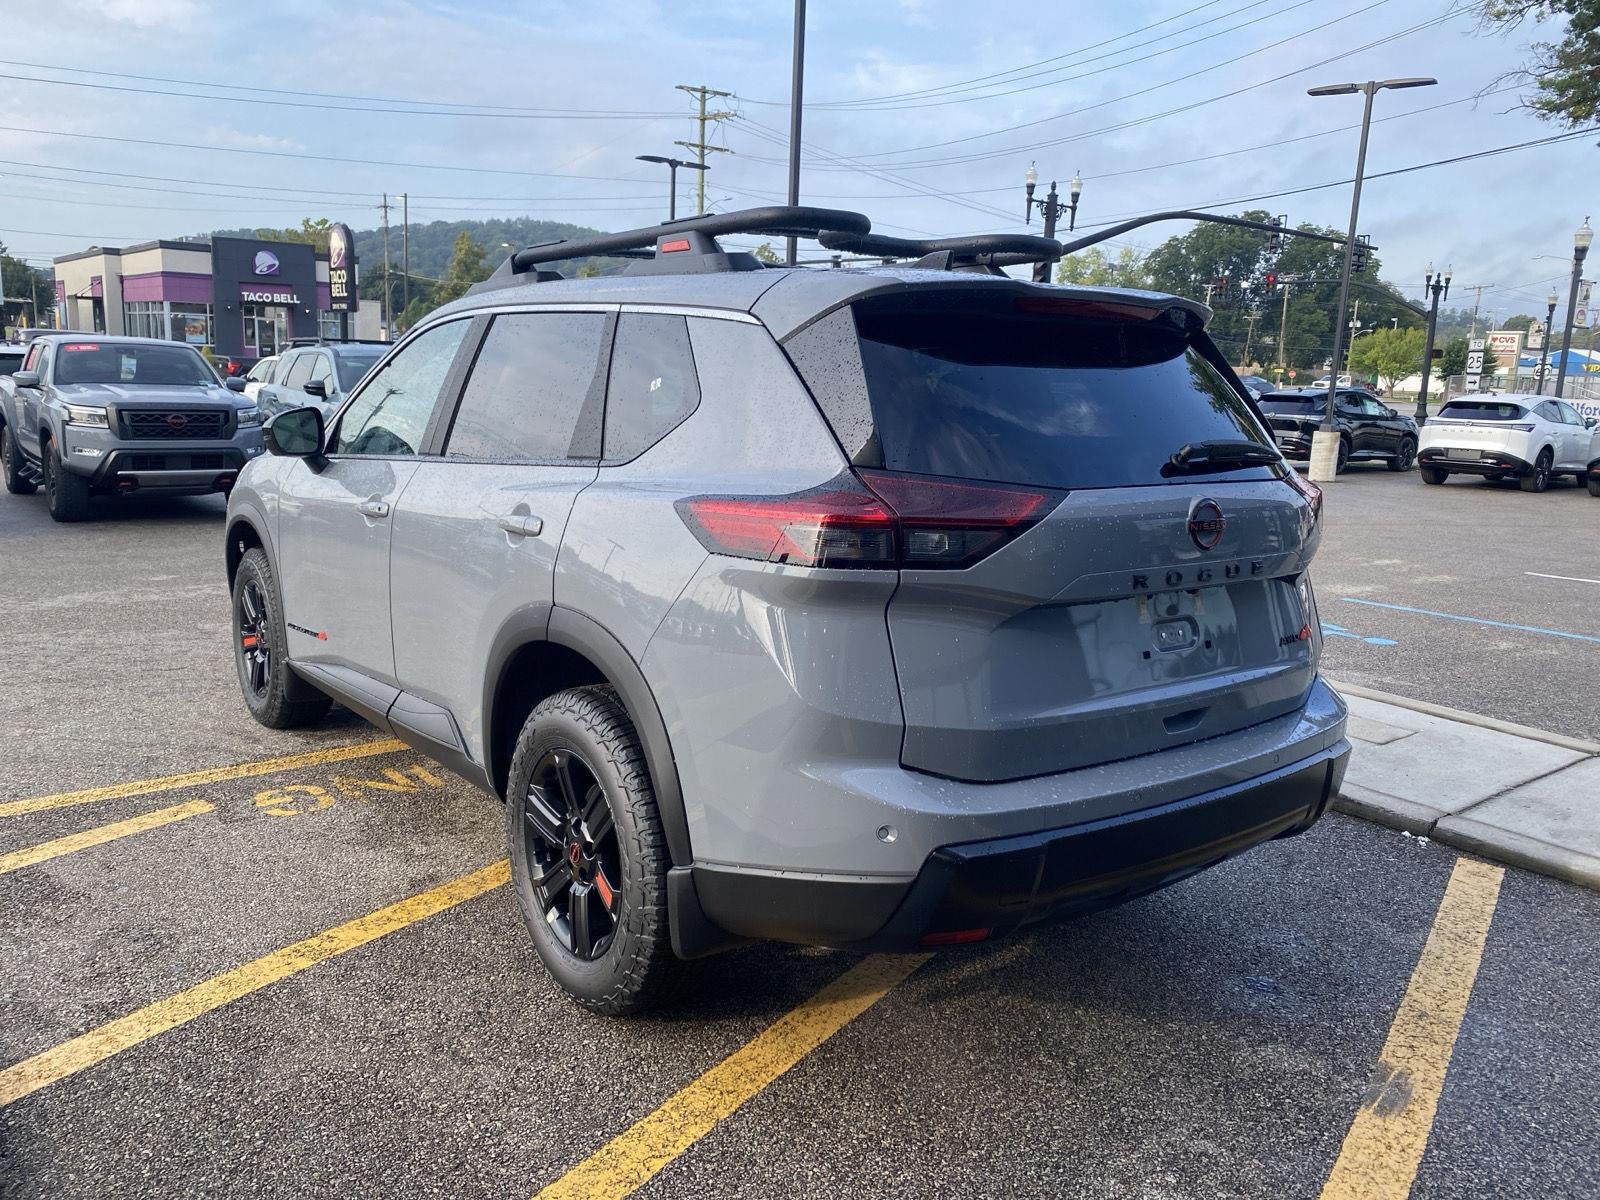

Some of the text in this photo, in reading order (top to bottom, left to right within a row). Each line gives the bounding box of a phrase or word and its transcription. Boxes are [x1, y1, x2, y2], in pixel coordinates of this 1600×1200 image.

[330, 270, 346, 283] TACO
[331, 283, 348, 297] BELL
[242, 292, 301, 304] TACO BELL
[1499, 336, 1516, 344] CVS
[1468, 356, 1482, 369] 25
[1132, 561, 1264, 590] ROGUE
